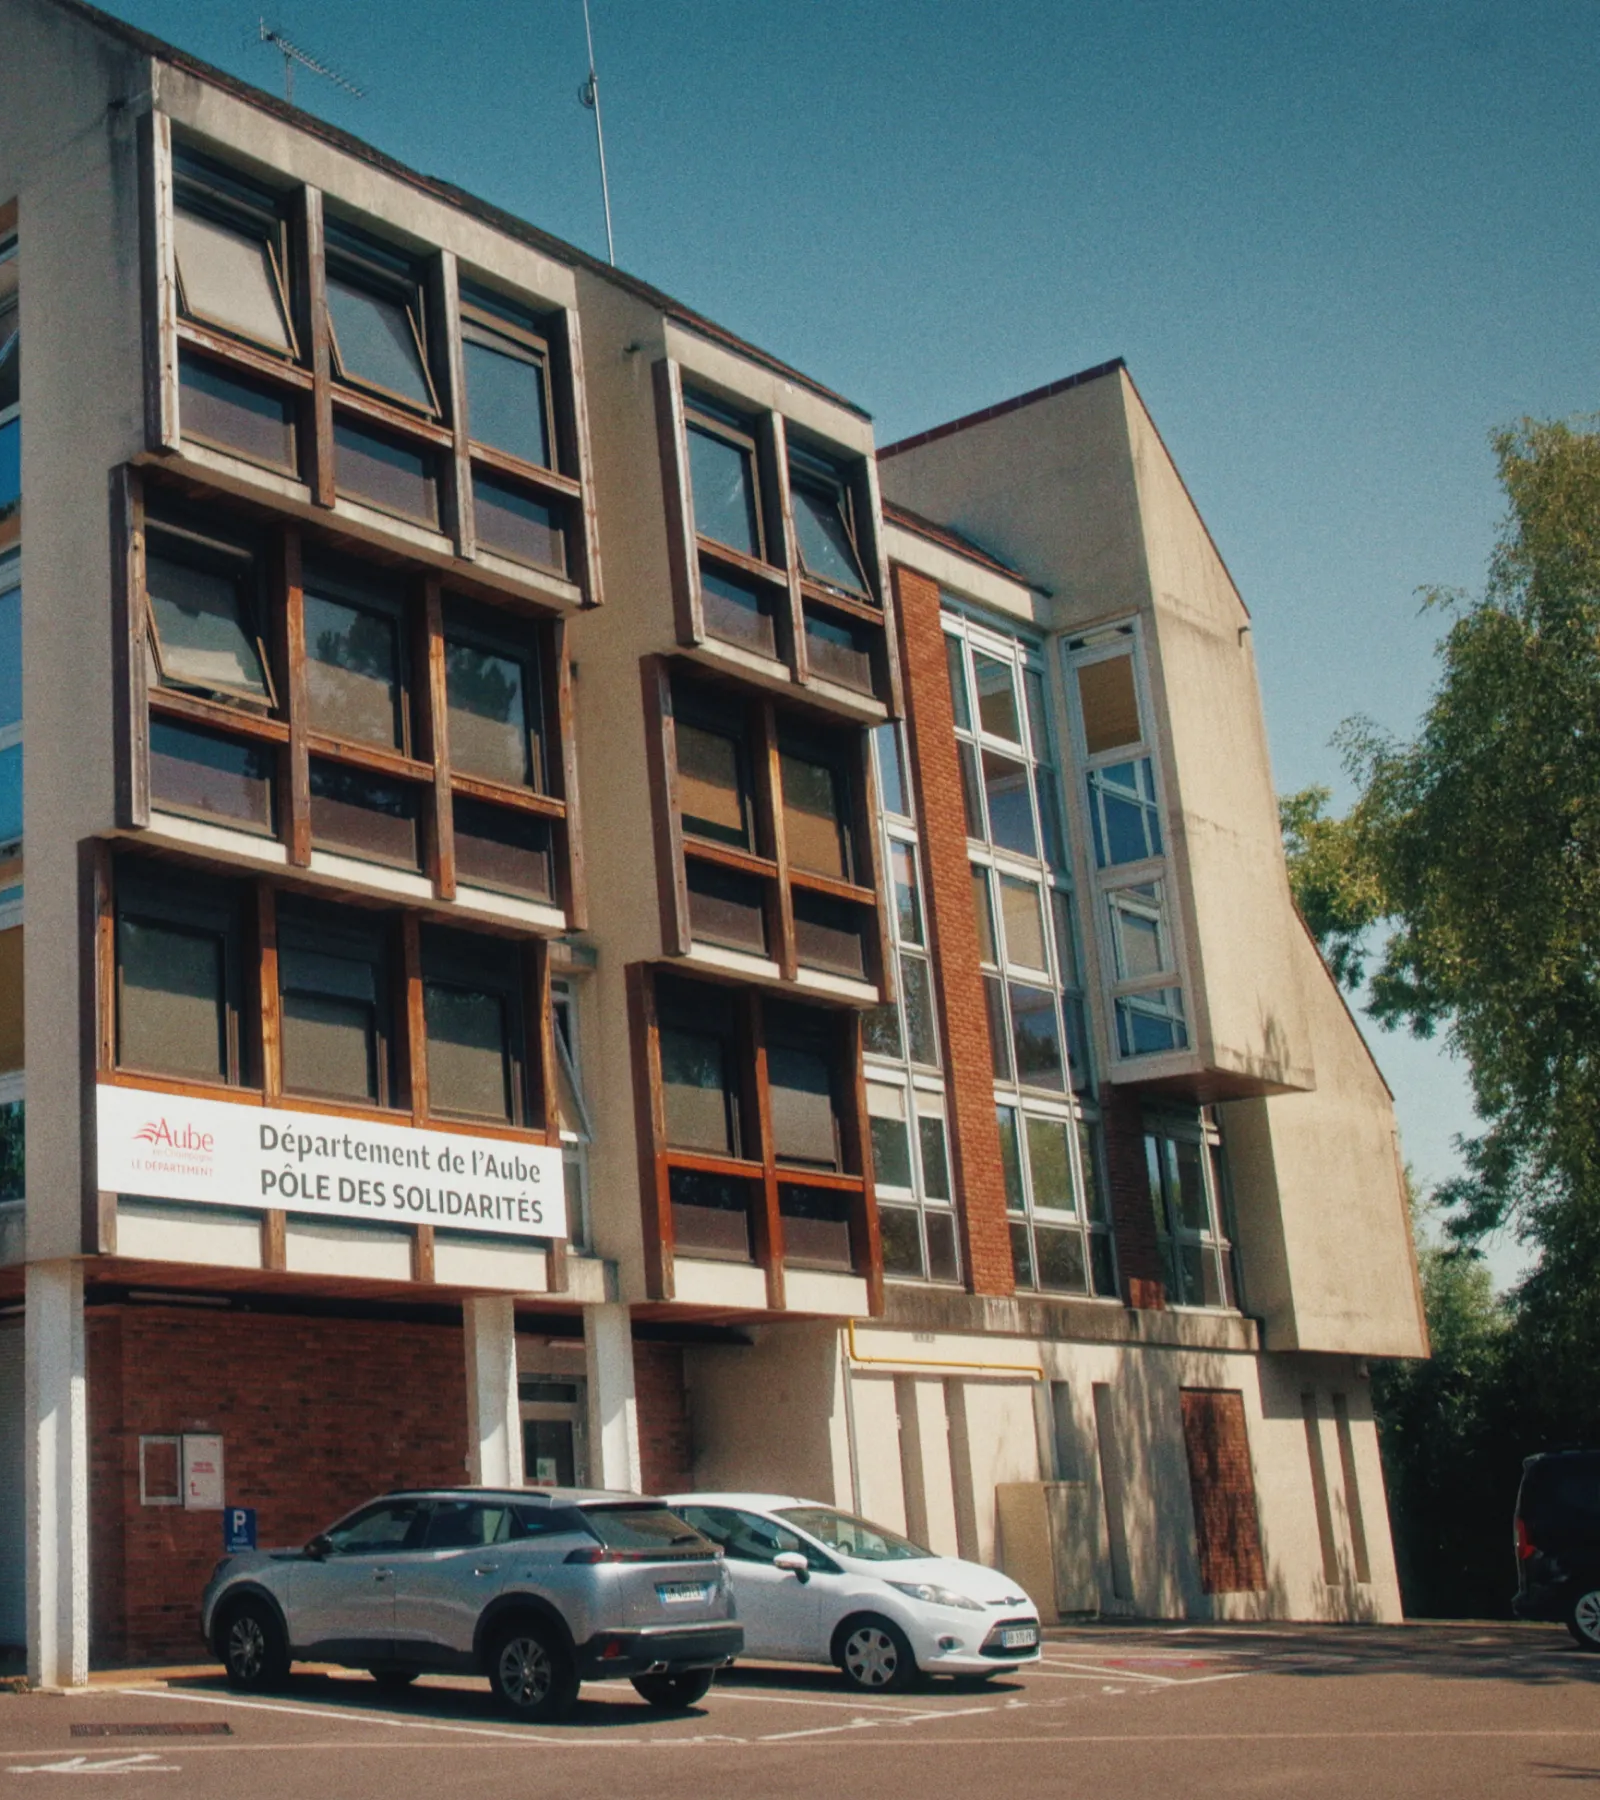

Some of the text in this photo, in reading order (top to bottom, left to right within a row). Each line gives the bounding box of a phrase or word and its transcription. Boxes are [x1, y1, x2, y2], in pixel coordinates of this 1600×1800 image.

[153, 1117, 214, 1152] Aube
[259, 1124, 541, 1183] Département de l'Aube
[260, 1162, 543, 1225] PÔLE DES SOLIDARITÉS
[233, 1510, 247, 1534] P
